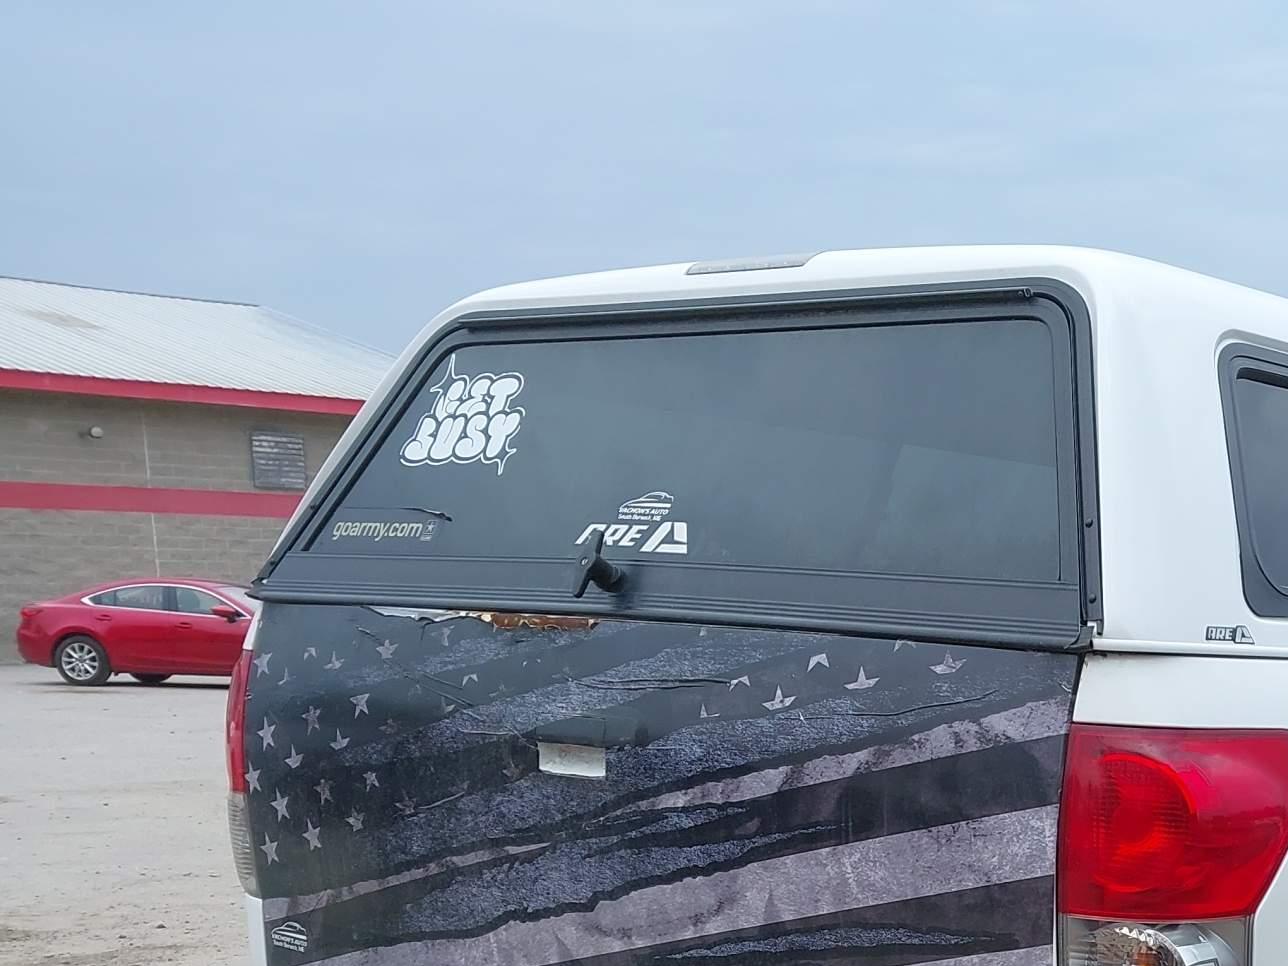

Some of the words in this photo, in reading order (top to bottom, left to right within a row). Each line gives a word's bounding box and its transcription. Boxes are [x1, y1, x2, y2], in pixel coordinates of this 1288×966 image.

[435, 376, 520, 421] GET
[403, 411, 521, 461] BUSY
[332, 520, 422, 541] goarmy.com
